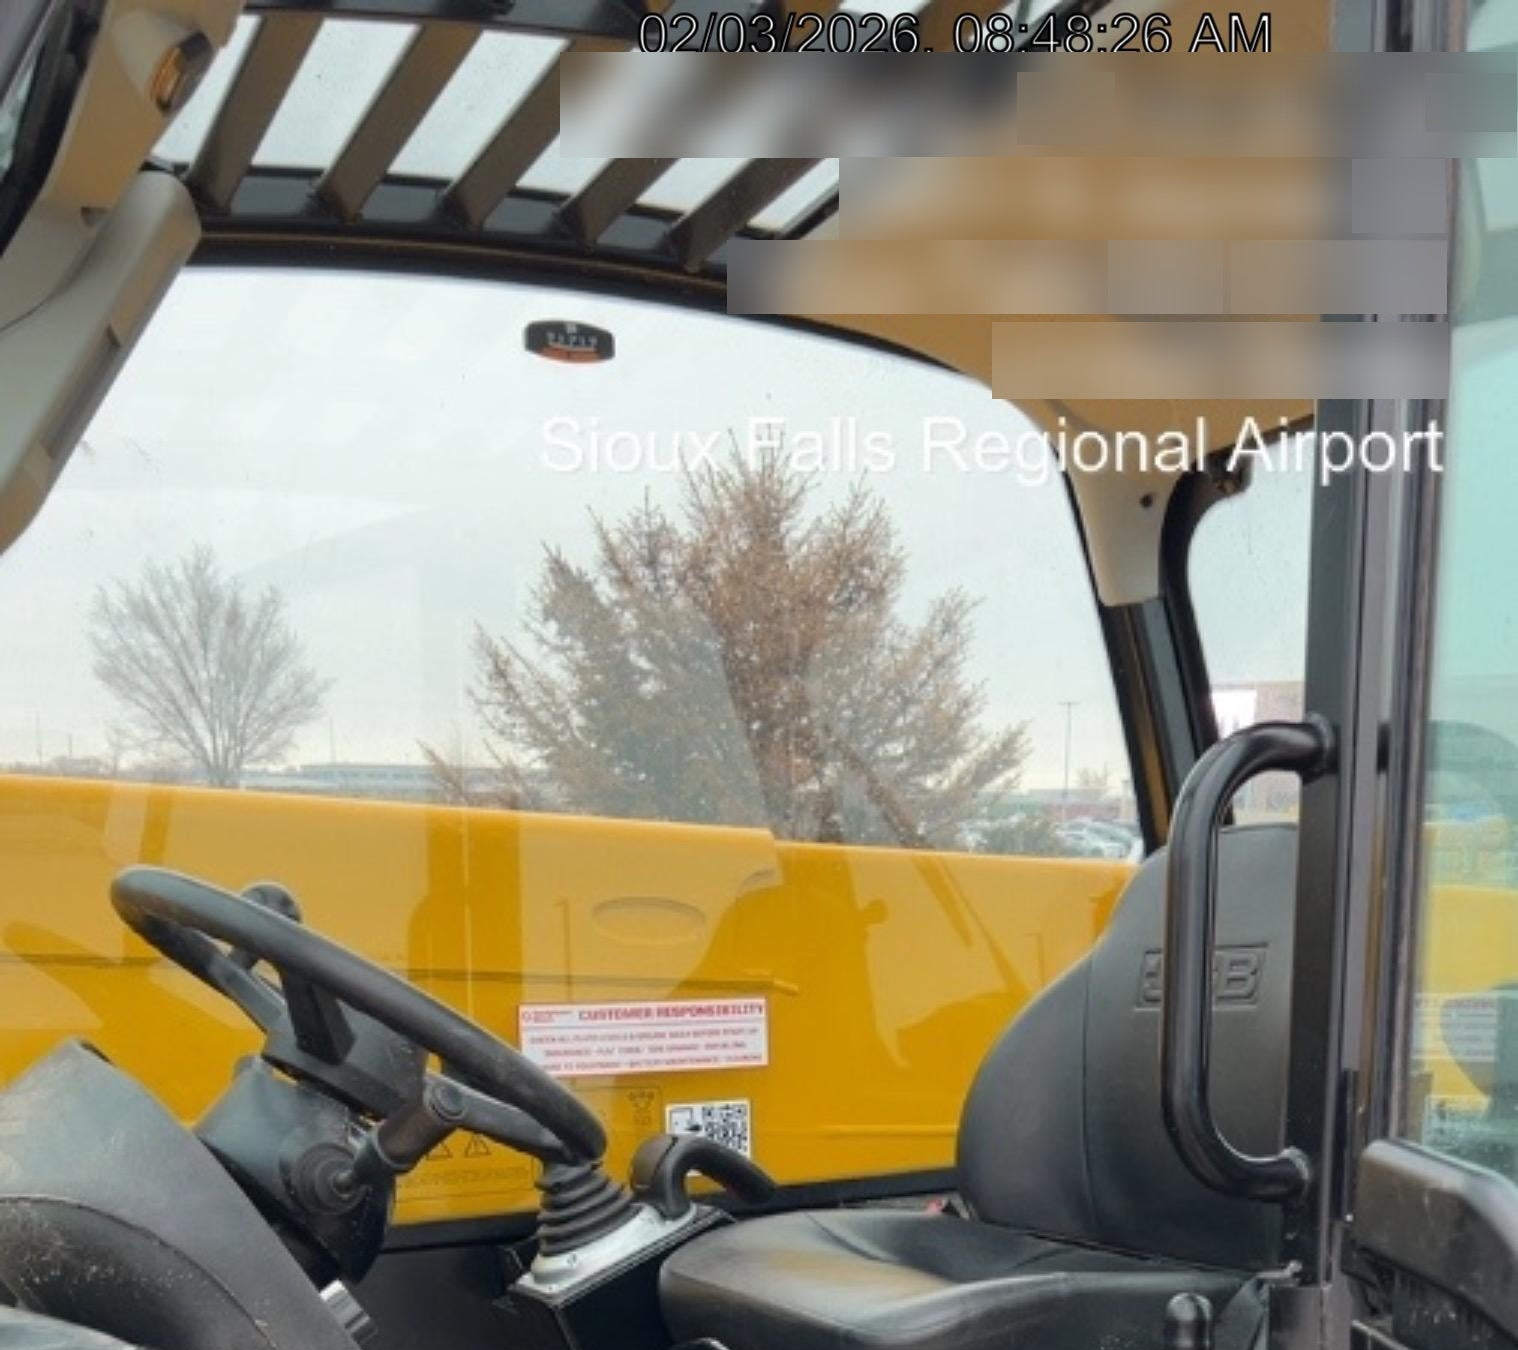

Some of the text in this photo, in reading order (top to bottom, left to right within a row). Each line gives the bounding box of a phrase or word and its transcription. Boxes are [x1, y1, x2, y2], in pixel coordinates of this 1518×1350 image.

[1138, 945, 1265, 1005] JB
[578, 1007, 651, 1021] CUSTOMER
[656, 1003, 762, 1018] RESPONSIBILITY
